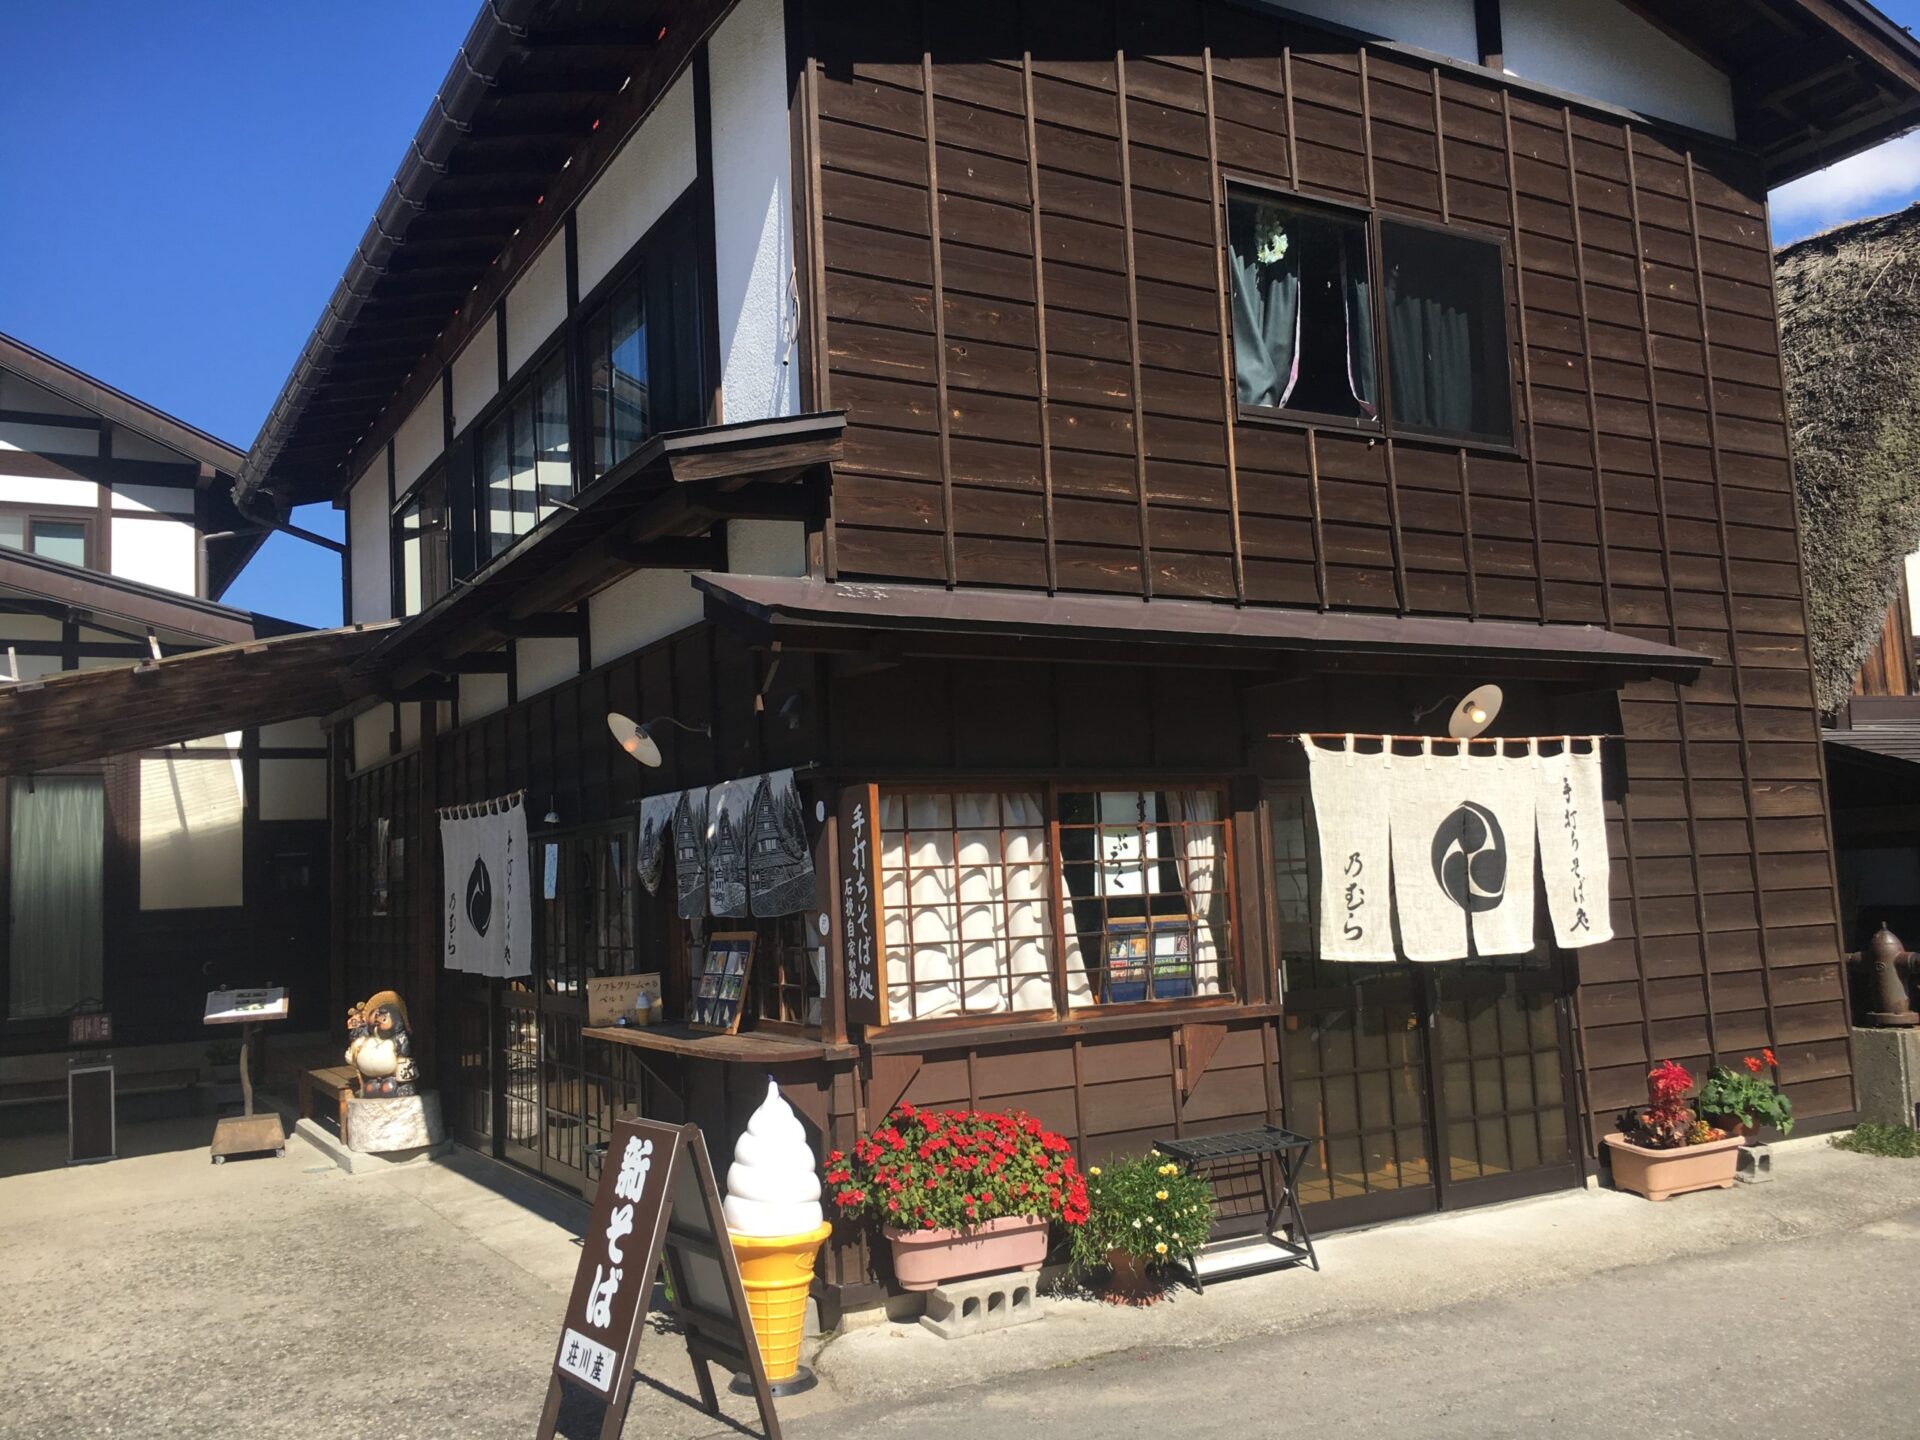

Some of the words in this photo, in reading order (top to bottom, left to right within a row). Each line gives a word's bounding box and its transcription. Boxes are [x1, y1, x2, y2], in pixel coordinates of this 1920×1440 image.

[851, 803, 875, 1000] 手打ちそば処
[1343, 851, 1365, 941] 乃むら
[1562, 777, 1590, 932] 手打ちそば処
[844, 878, 858, 999] 石挽自家製粉
[585, 1135, 653, 1329] 新そば
[565, 1339, 605, 1383] 荘川産
